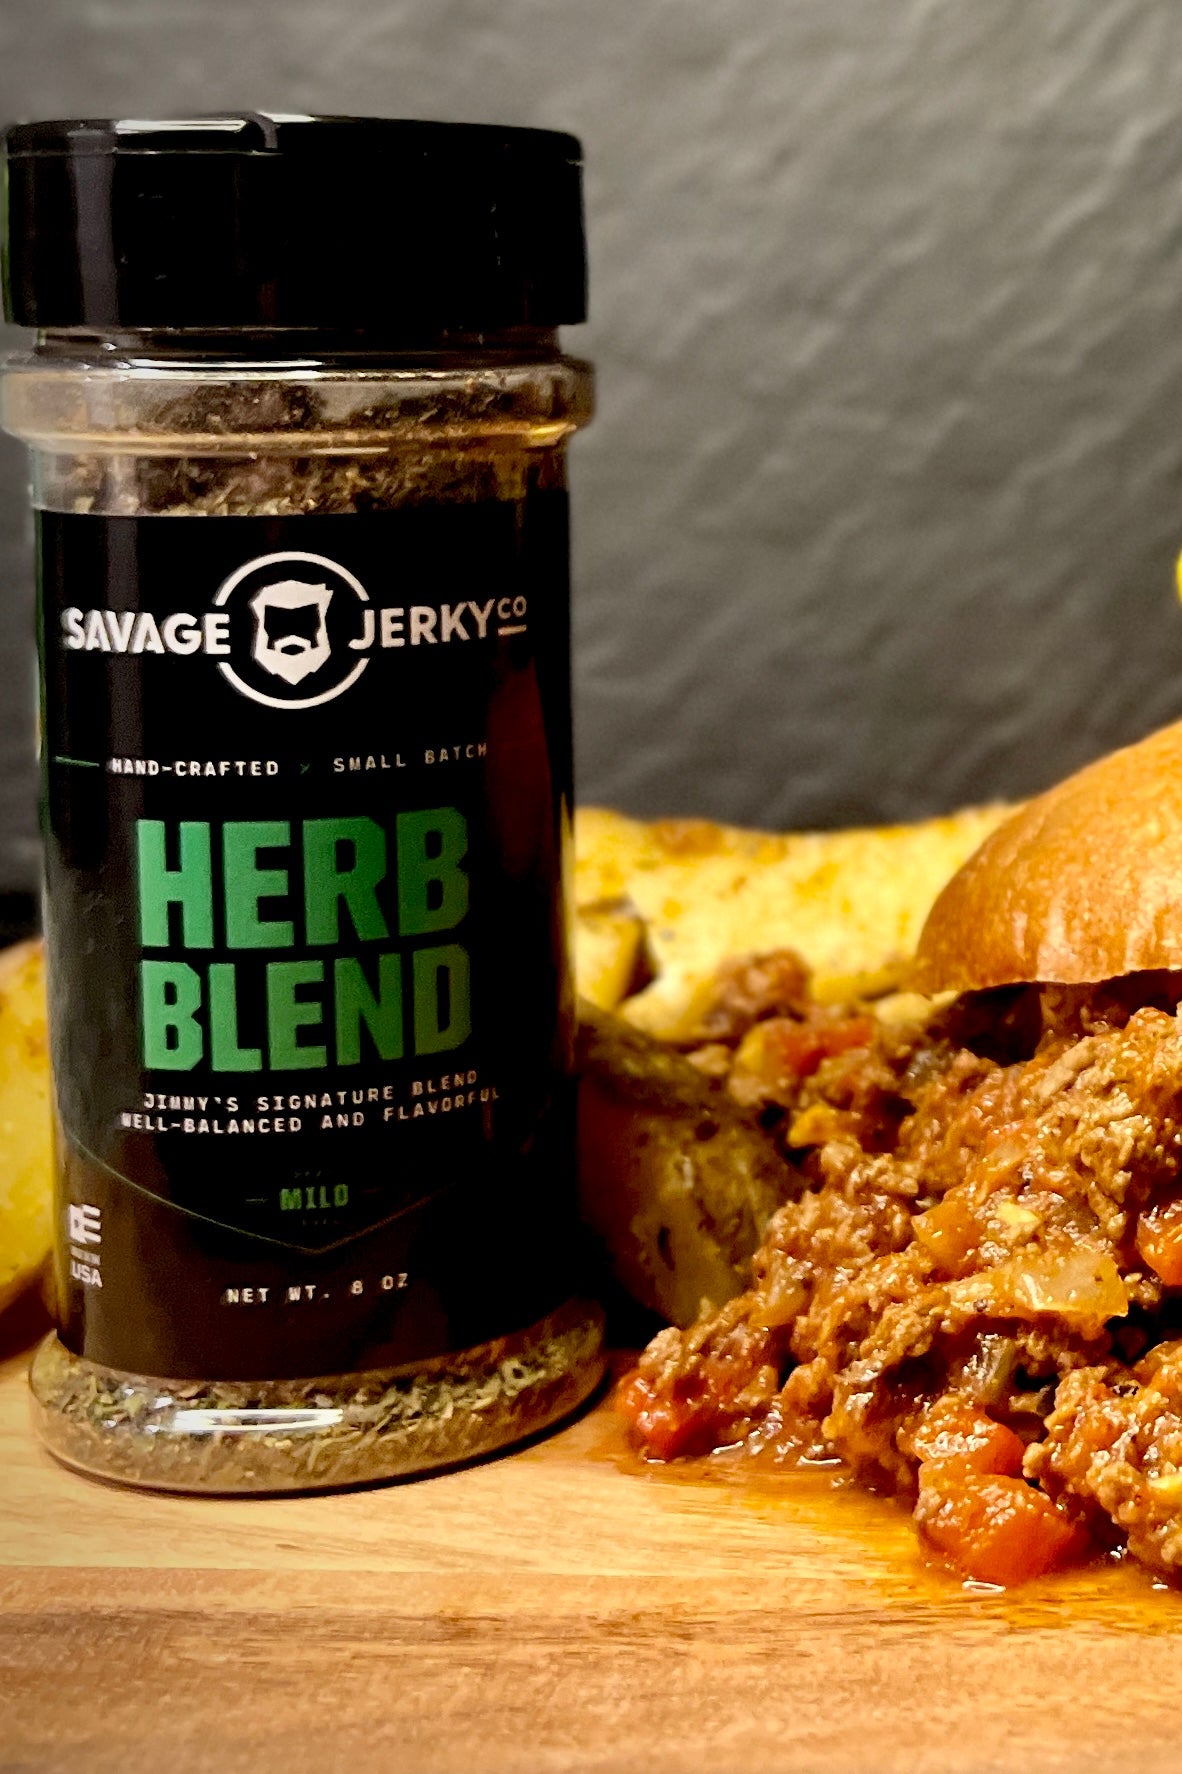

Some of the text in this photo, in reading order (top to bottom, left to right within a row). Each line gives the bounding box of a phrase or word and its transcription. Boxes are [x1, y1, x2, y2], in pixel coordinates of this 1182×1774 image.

[63, 608, 231, 655] SAVAGE
[349, 599, 495, 651] JERKY
[110, 742, 488, 777] HAND-CRAFTED SMALL BATCH
[137, 807, 469, 949] HERB
[141, 944, 472, 1072] BLEND
[119, 1088, 500, 1134] WELL-BALANCED AND FLAVORFUL
[257, 1085, 394, 1112] SIGNATURE
[411, 1069, 478, 1097] BLEND
[279, 1183, 349, 1211] MILD
[226, 1272, 410, 1304] NET WT. 8 OZ
